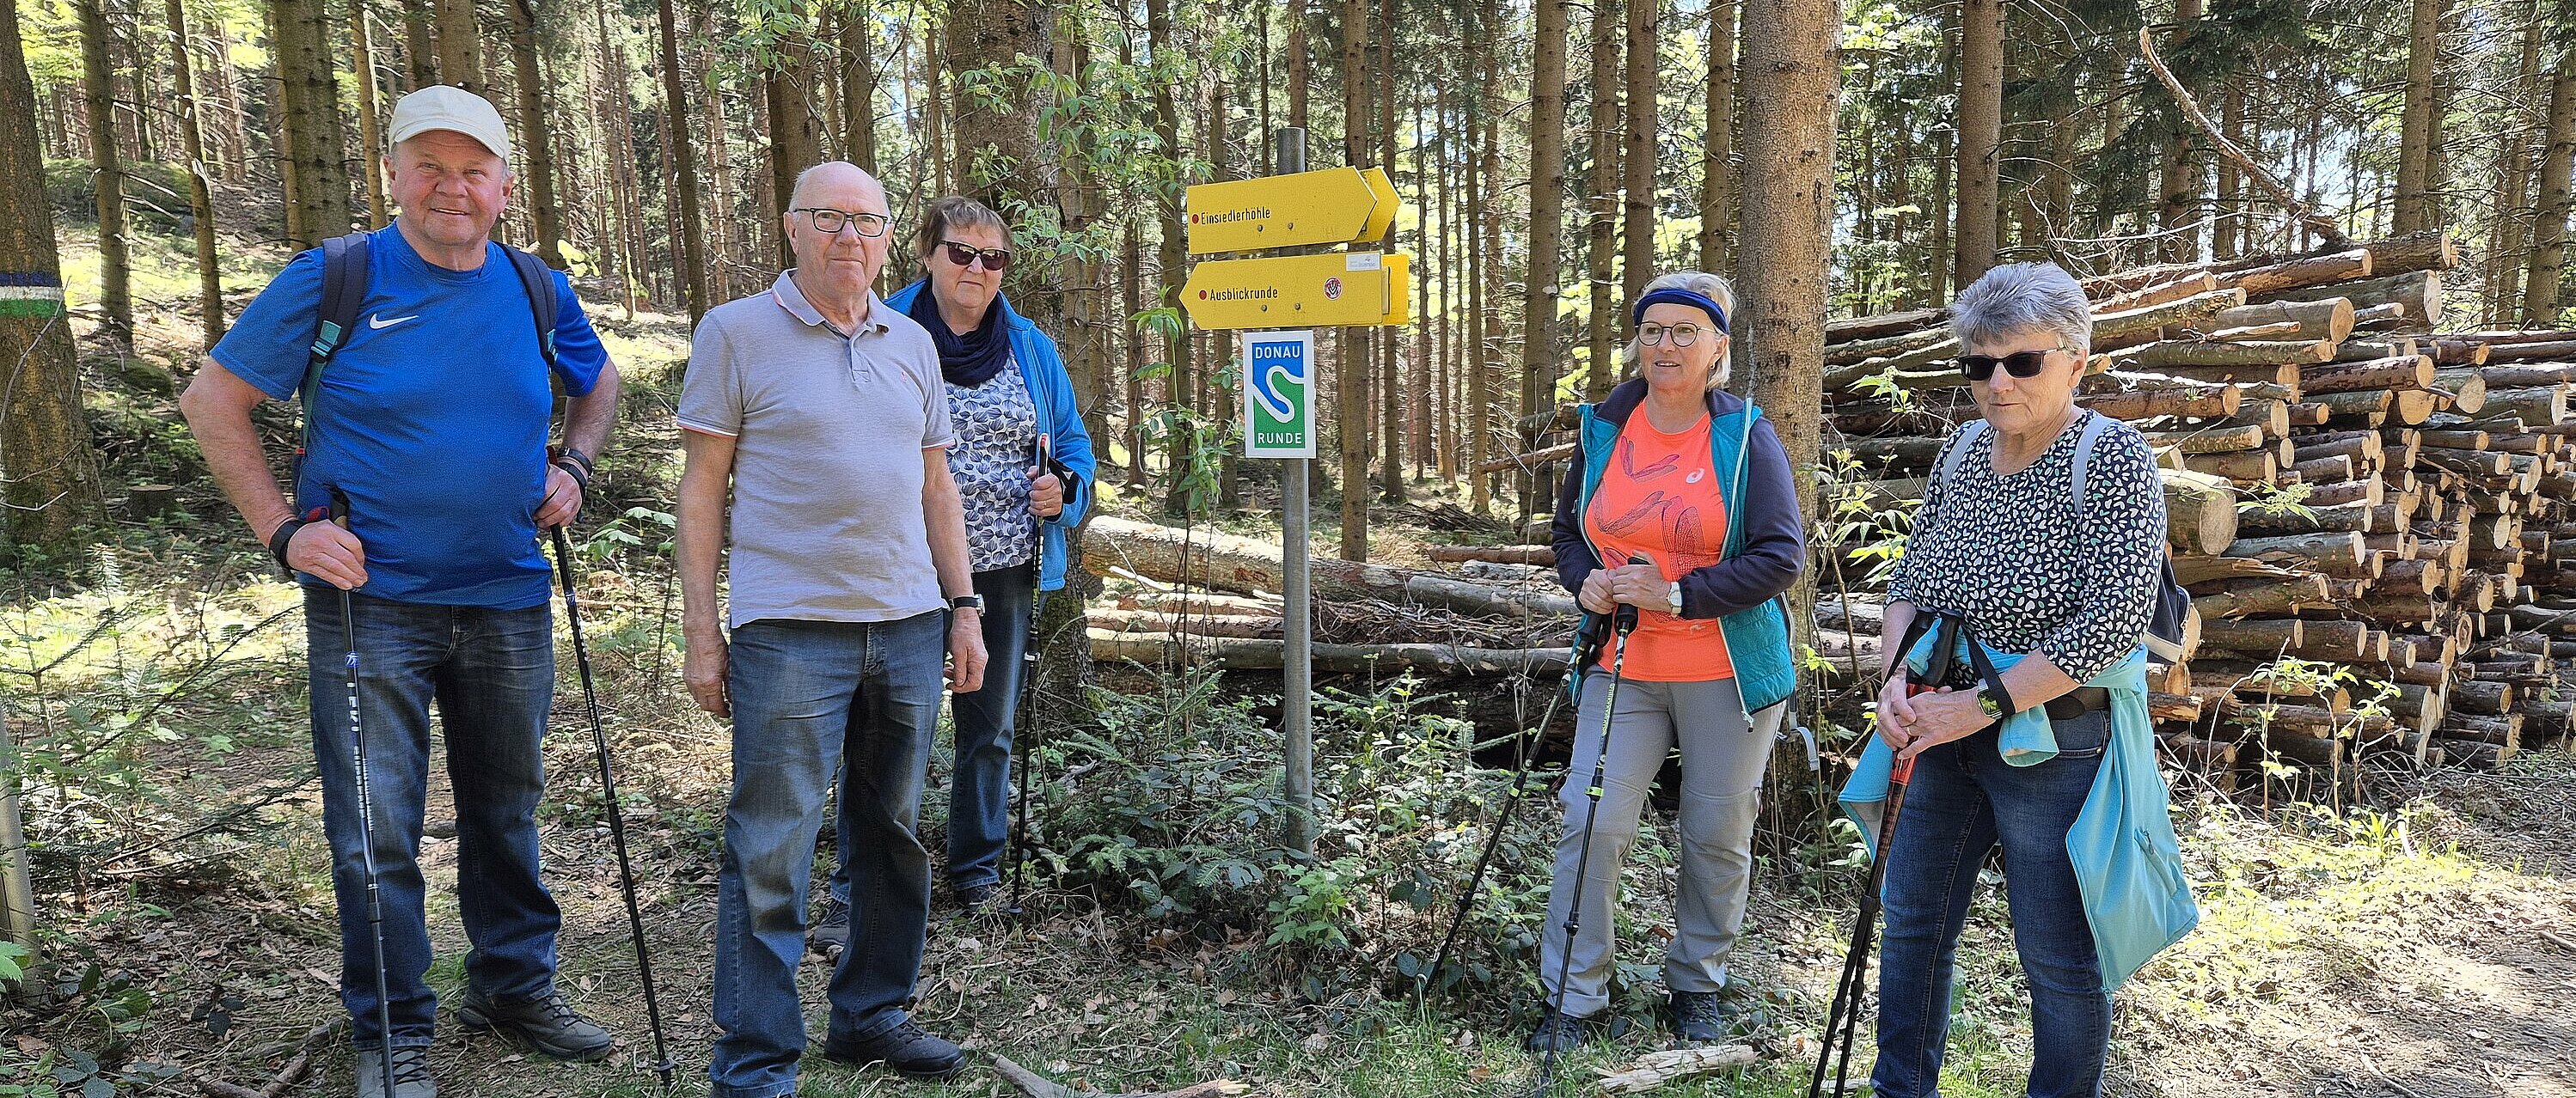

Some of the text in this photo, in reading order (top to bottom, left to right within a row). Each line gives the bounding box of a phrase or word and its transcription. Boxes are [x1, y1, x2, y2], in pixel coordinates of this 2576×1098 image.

[1201, 206, 1270, 225] Einsiedlerhöhle
[1209, 285, 1278, 302] Ausblickrunde
[1255, 345, 1300, 359] DONAU
[1257, 432, 1302, 444] RUNDE
